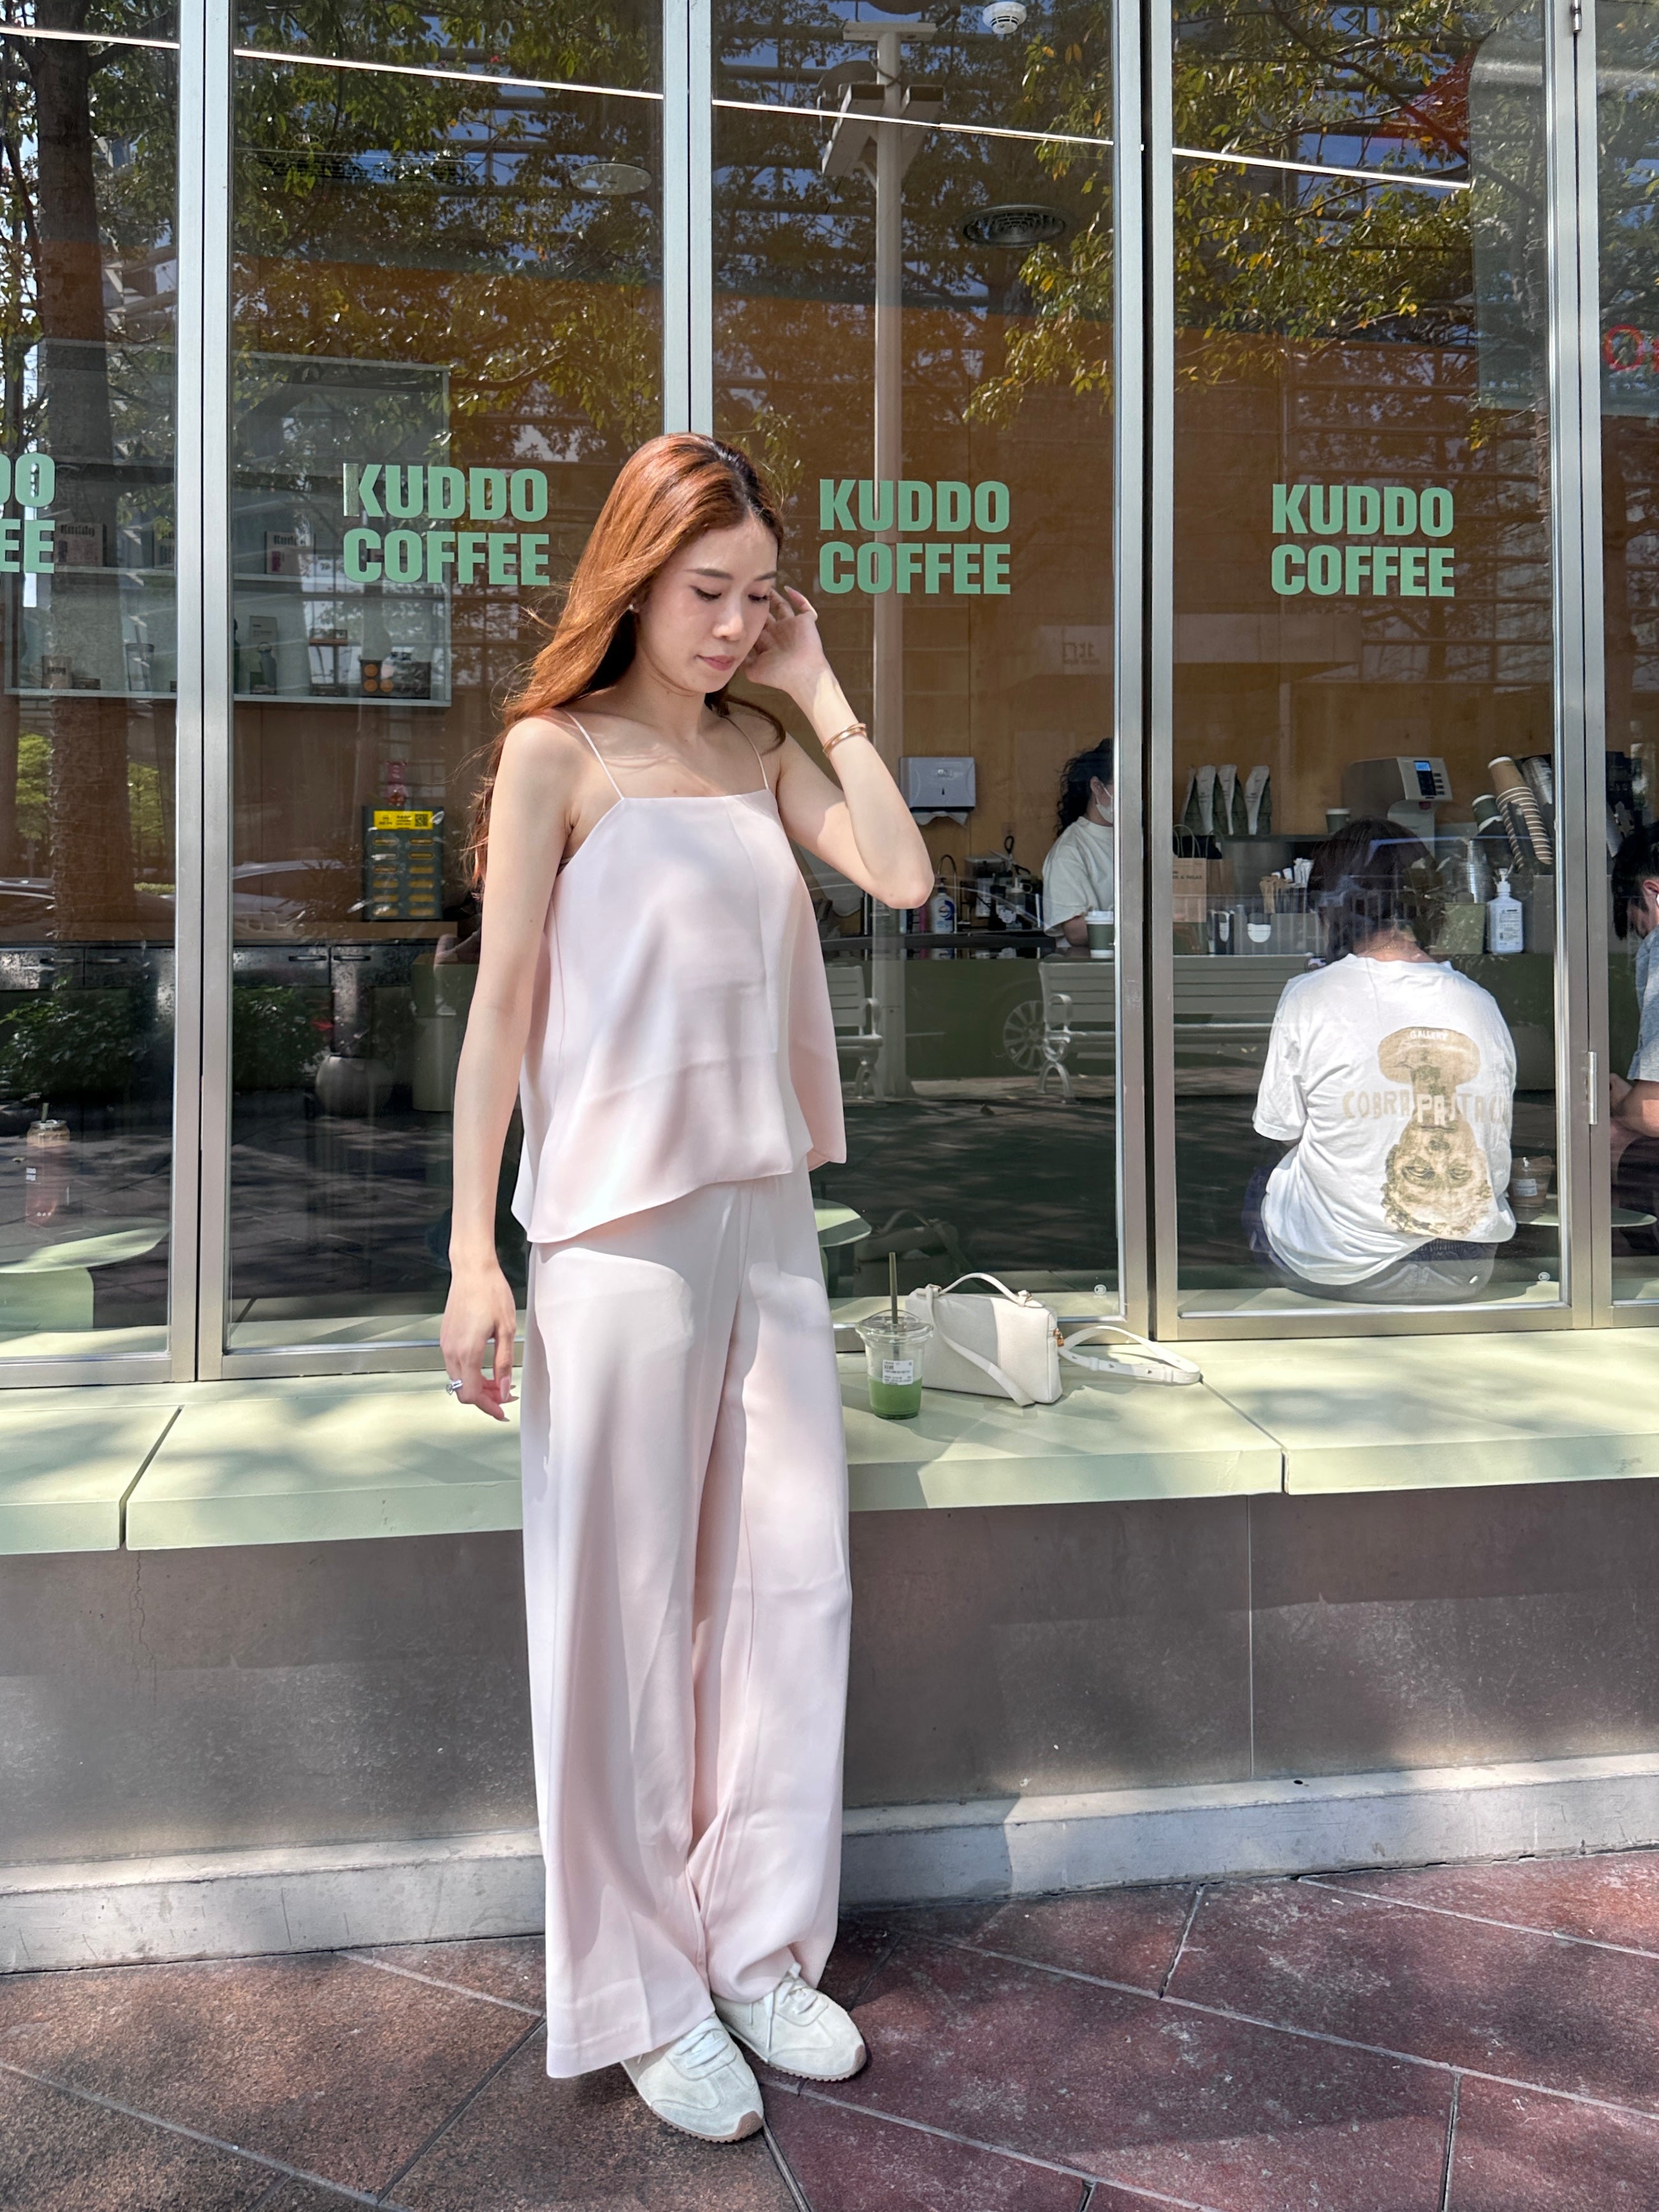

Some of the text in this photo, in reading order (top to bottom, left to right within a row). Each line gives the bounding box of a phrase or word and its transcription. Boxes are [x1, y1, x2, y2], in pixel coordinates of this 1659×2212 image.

[0, 453, 55, 507] O
[343, 463, 548, 522] KUDDO
[820, 479, 1009, 532] KUDDO
[1273, 484, 1453, 537] KUDDO
[344, 529, 550, 585] COFFEE
[820, 542, 1011, 594] COFFEE
[1271, 545, 1454, 597] COFFEE
[1341, 1089, 1411, 1120] COBRA
